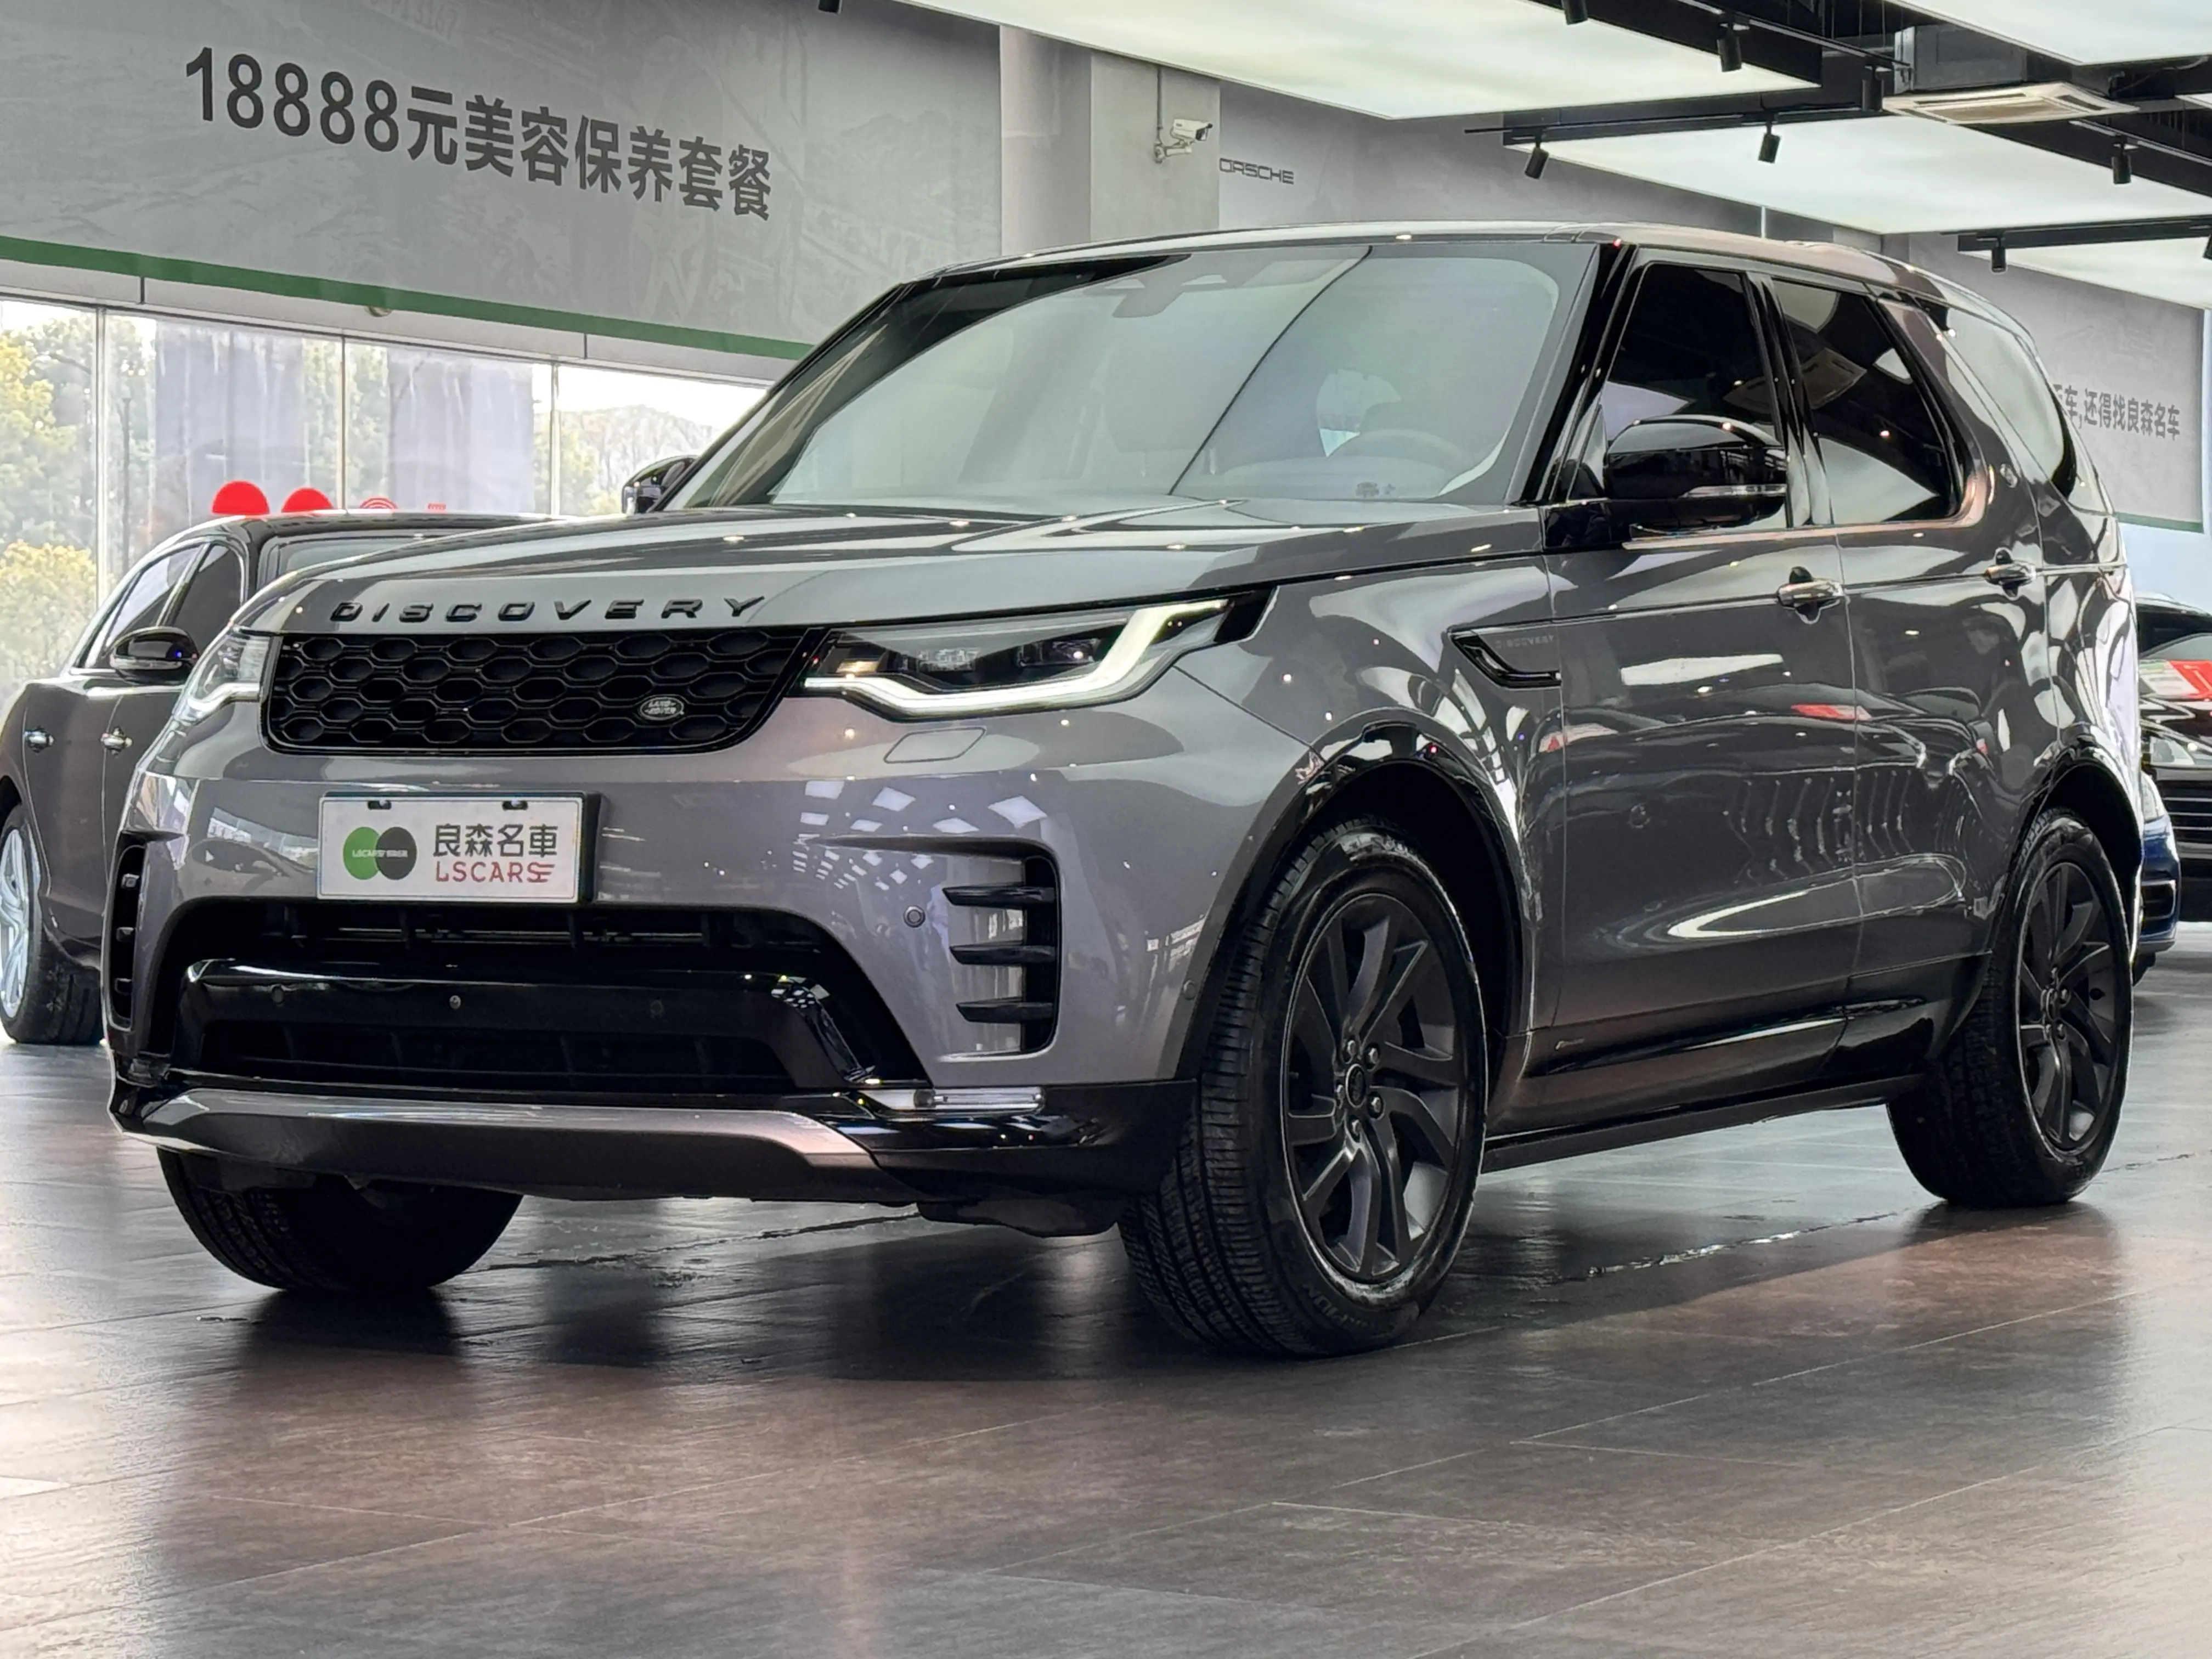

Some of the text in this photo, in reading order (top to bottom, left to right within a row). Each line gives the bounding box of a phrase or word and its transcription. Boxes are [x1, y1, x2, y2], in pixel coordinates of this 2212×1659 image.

[185, 46, 771, 220] 18888元美容保养套餐
[1219, 157, 1294, 185] ORSCHE
[329, 595, 765, 623] DISCOVERY
[433, 823, 558, 859] 良森名車
